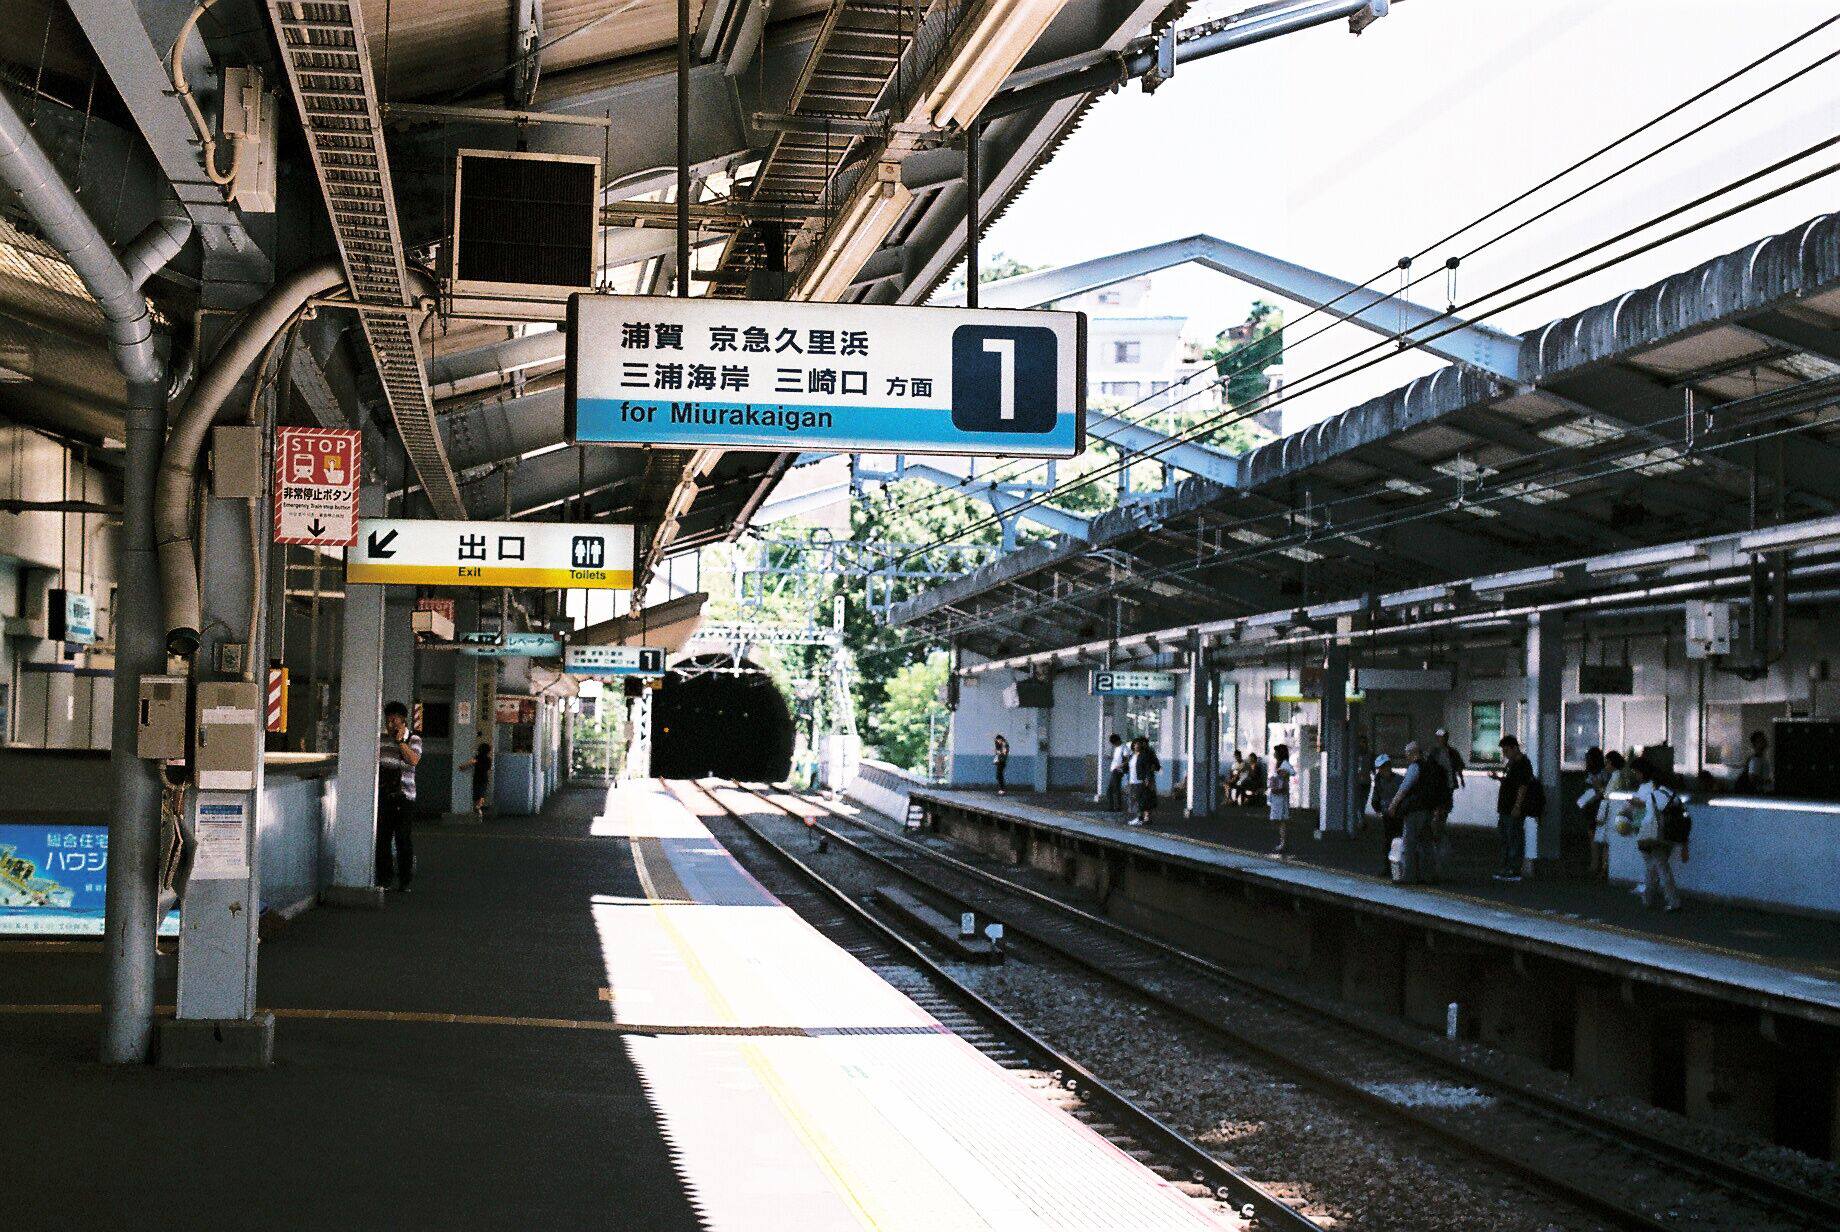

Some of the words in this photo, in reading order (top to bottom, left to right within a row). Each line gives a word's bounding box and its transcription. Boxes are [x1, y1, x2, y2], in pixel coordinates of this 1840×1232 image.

[620, 321, 684, 351] 浦賀
[708, 324, 869, 357] 京急久里浜
[620, 361, 751, 392] 三浦海岸
[774, 367, 869, 396] 三崎口
[886, 377, 933, 399] 方面
[982, 338, 1015, 420] 1
[620, 401, 657, 423] for
[670, 402, 833, 432] Miurakaigan
[292, 438, 346, 453] STOP
[283, 486, 352, 501] 非常停止ボタン
[458, 533, 525, 562] 出口
[458, 566, 481, 578] Exit
[569, 569, 606, 581] Toilets
[644, 652, 654, 670] 1
[1098, 675, 1112, 691] 2
